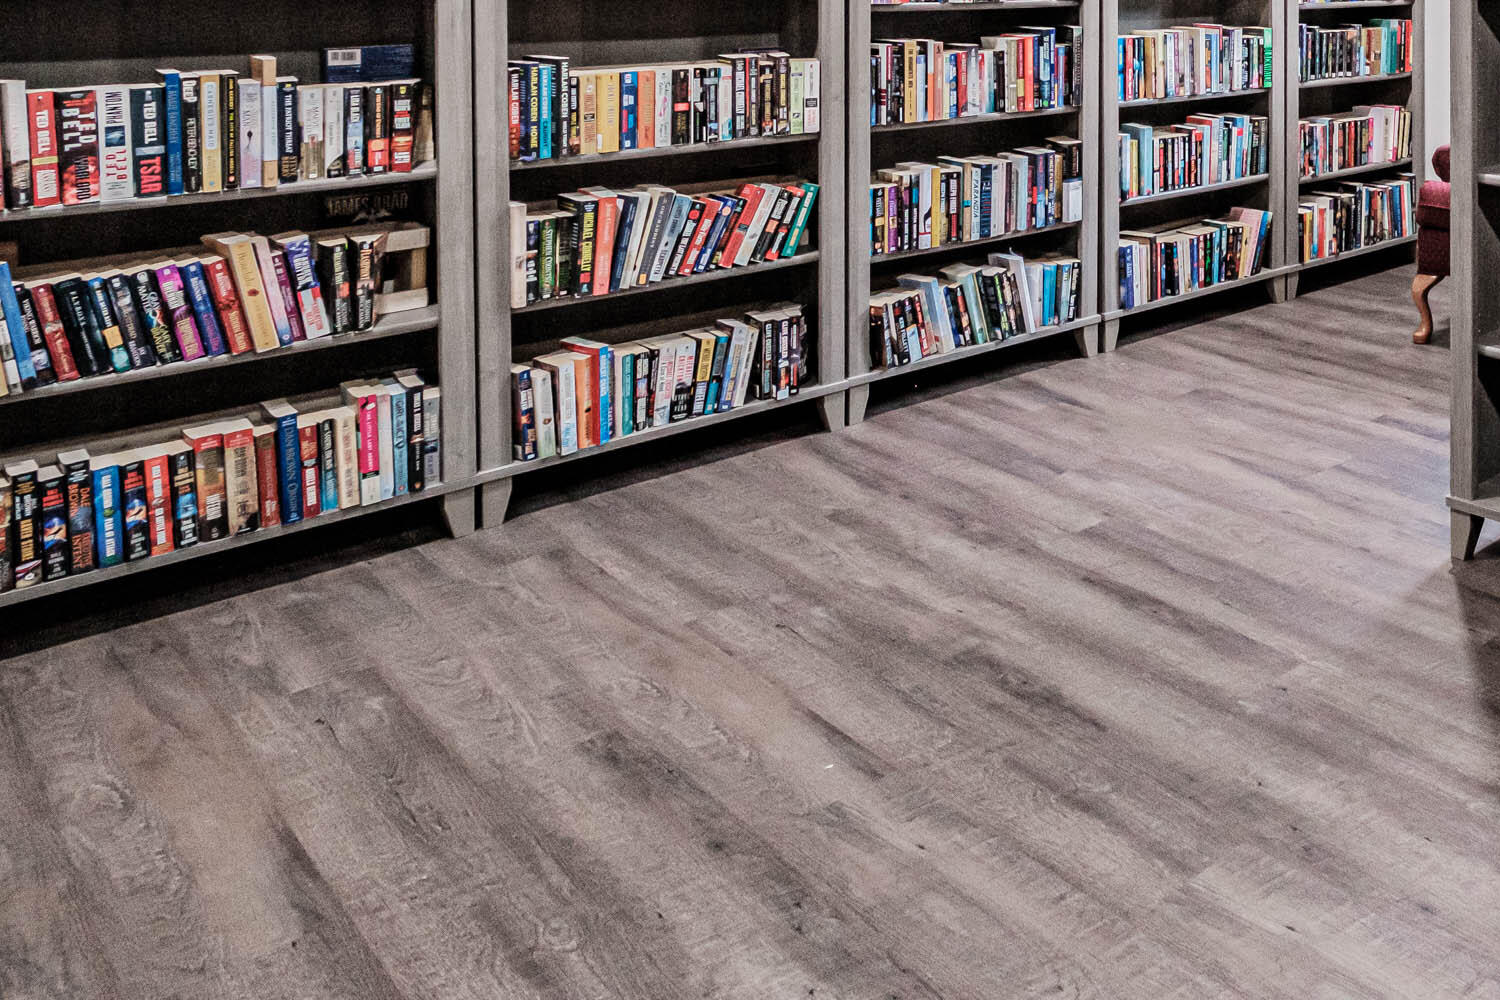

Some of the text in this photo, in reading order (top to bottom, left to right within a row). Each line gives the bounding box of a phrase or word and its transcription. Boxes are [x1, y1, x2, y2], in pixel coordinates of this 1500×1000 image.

[561, 62, 569, 91] HARLAN
[105, 91, 124, 124] PHANTOM
[511, 73, 519, 124] HARLAN COBEN
[35, 110, 51, 154] TED BELL
[62, 108, 81, 152] BELL
[79, 112, 96, 144] TED
[143, 102, 158, 144] TED BELL
[284, 106, 292, 131] PATRIOT
[186, 118, 197, 170] PETER BENCHLEY
[285, 132, 293, 153] THREAT
[74, 156, 91, 200] WARLORD
[106, 154, 116, 177] TED
[116, 149, 127, 180] BELL
[139, 156, 162, 194] TSAR
[545, 229, 554, 256] STEPHEN
[581, 212, 595, 271] MICHAEL CONNELLY
[360, 249, 371, 280] FLASHPOINT
[69, 291, 85, 325] FLYBOYS
[136, 285, 151, 314] MATTER
[160, 324, 171, 345] GARY
[284, 427, 297, 480] DAN BROWN
[68, 484, 81, 517] BROWN
[79, 487, 91, 507] DALE
[287, 483, 298, 511] ORIGIN
[71, 535, 83, 569] INTENT
